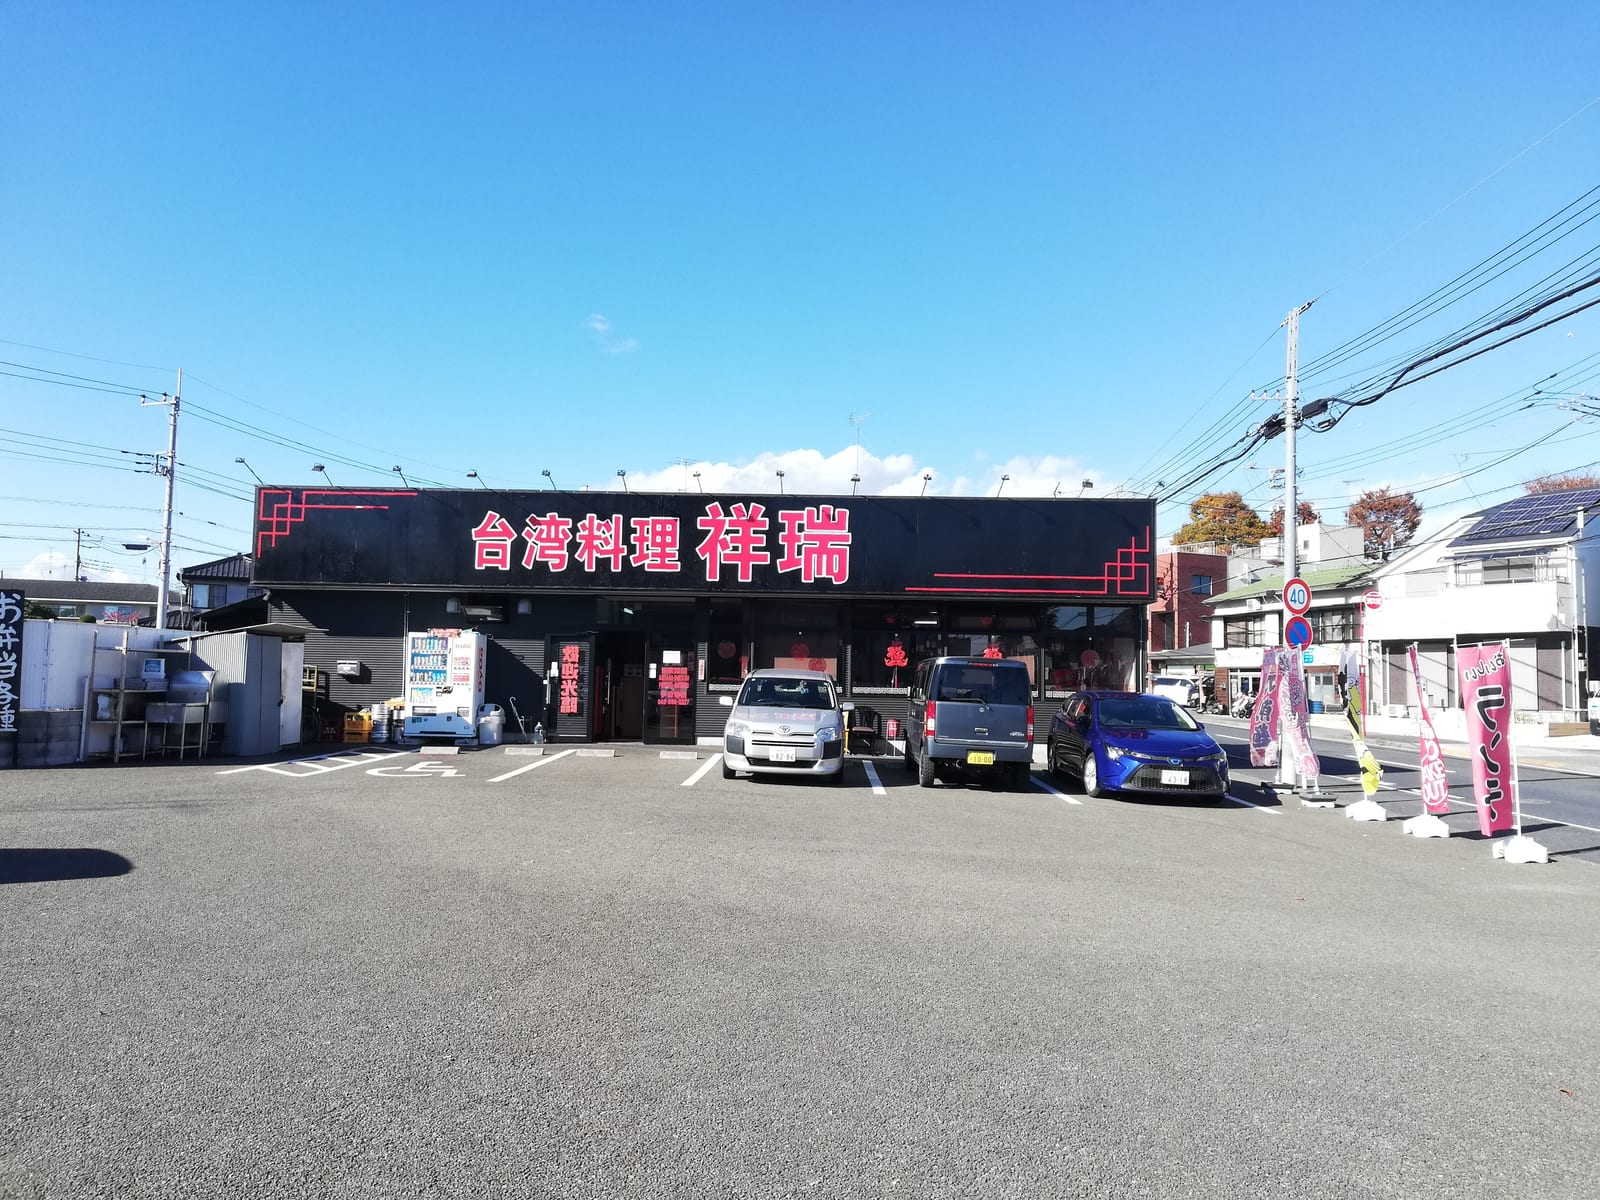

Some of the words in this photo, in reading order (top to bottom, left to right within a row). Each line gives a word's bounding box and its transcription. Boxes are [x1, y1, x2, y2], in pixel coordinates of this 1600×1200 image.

[471, 510, 681, 573] 台湾料理
[695, 500, 852, 585] 祥瑞
[1290, 588, 1305, 604] 40
[1422, 762, 1446, 783] AKE
